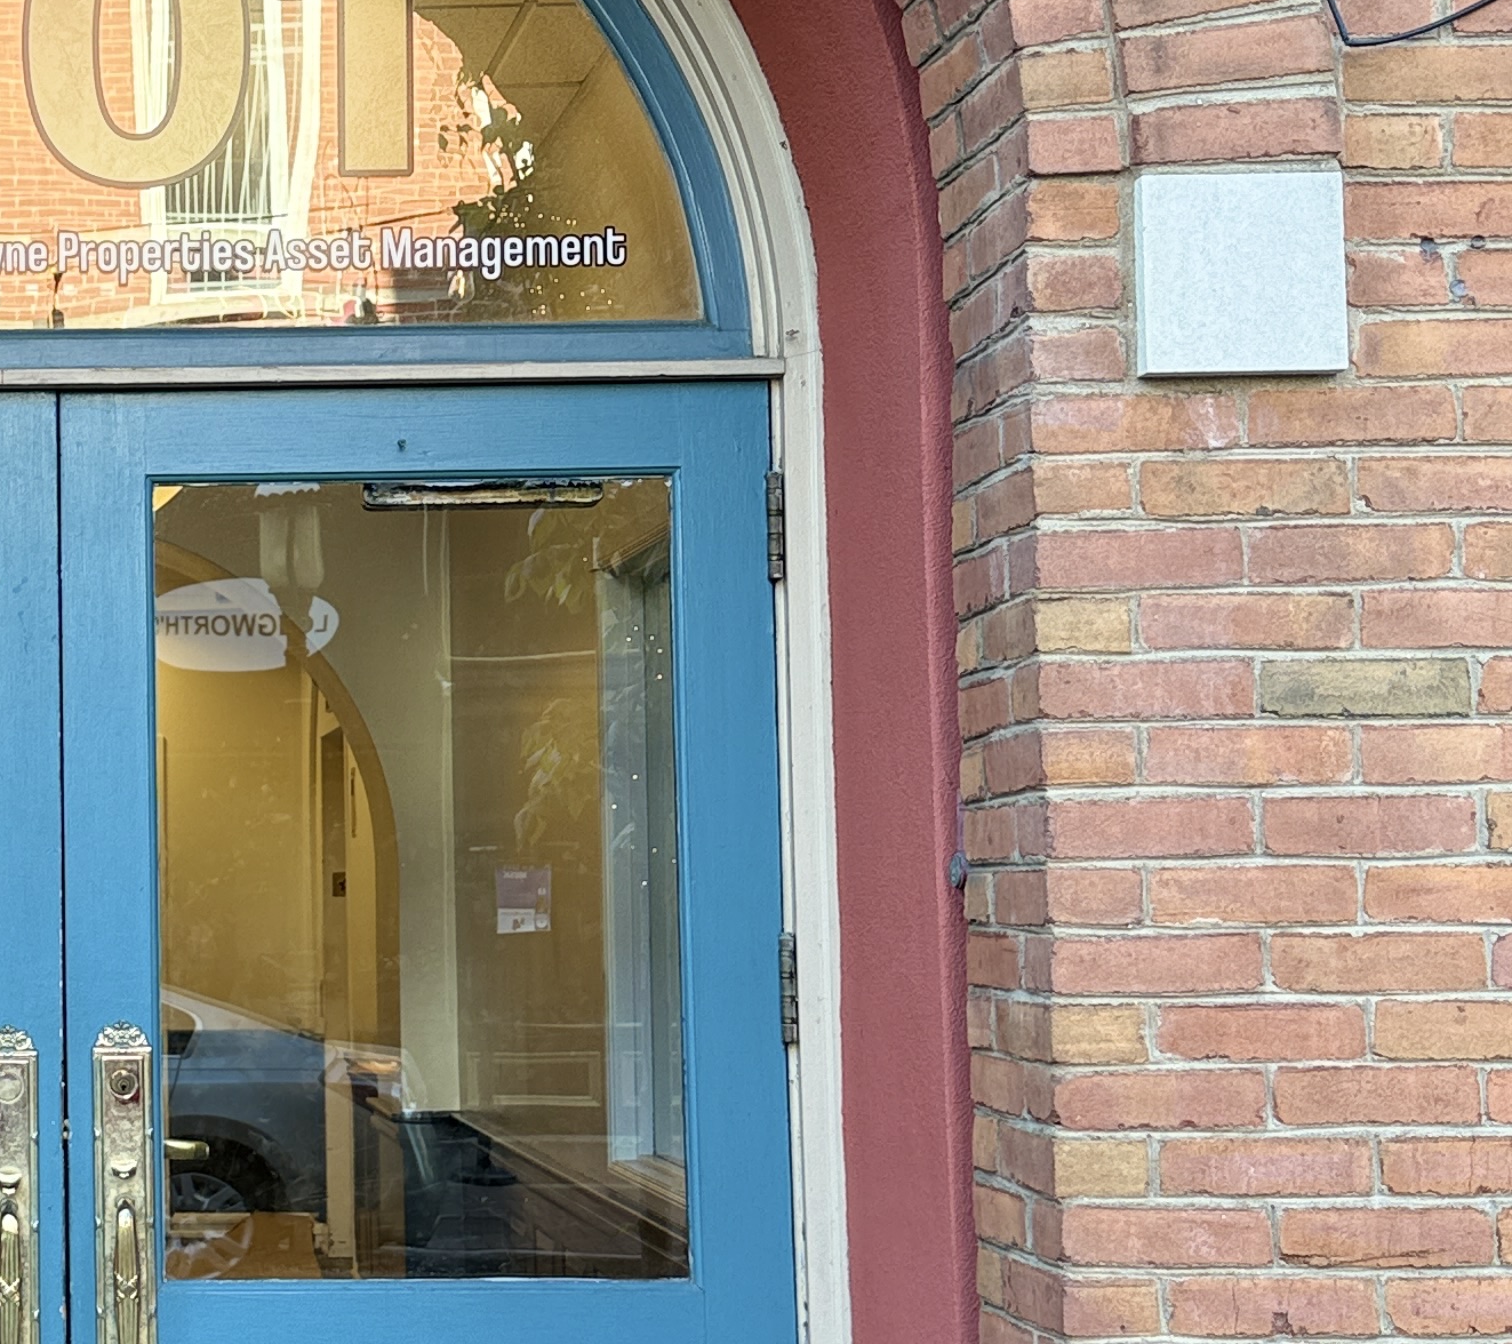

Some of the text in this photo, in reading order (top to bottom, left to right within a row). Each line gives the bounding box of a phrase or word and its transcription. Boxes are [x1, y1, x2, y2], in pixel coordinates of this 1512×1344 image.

[58, 229, 256, 284] Properties
[263, 228, 373, 272] Asset
[381, 226, 628, 282] Management
